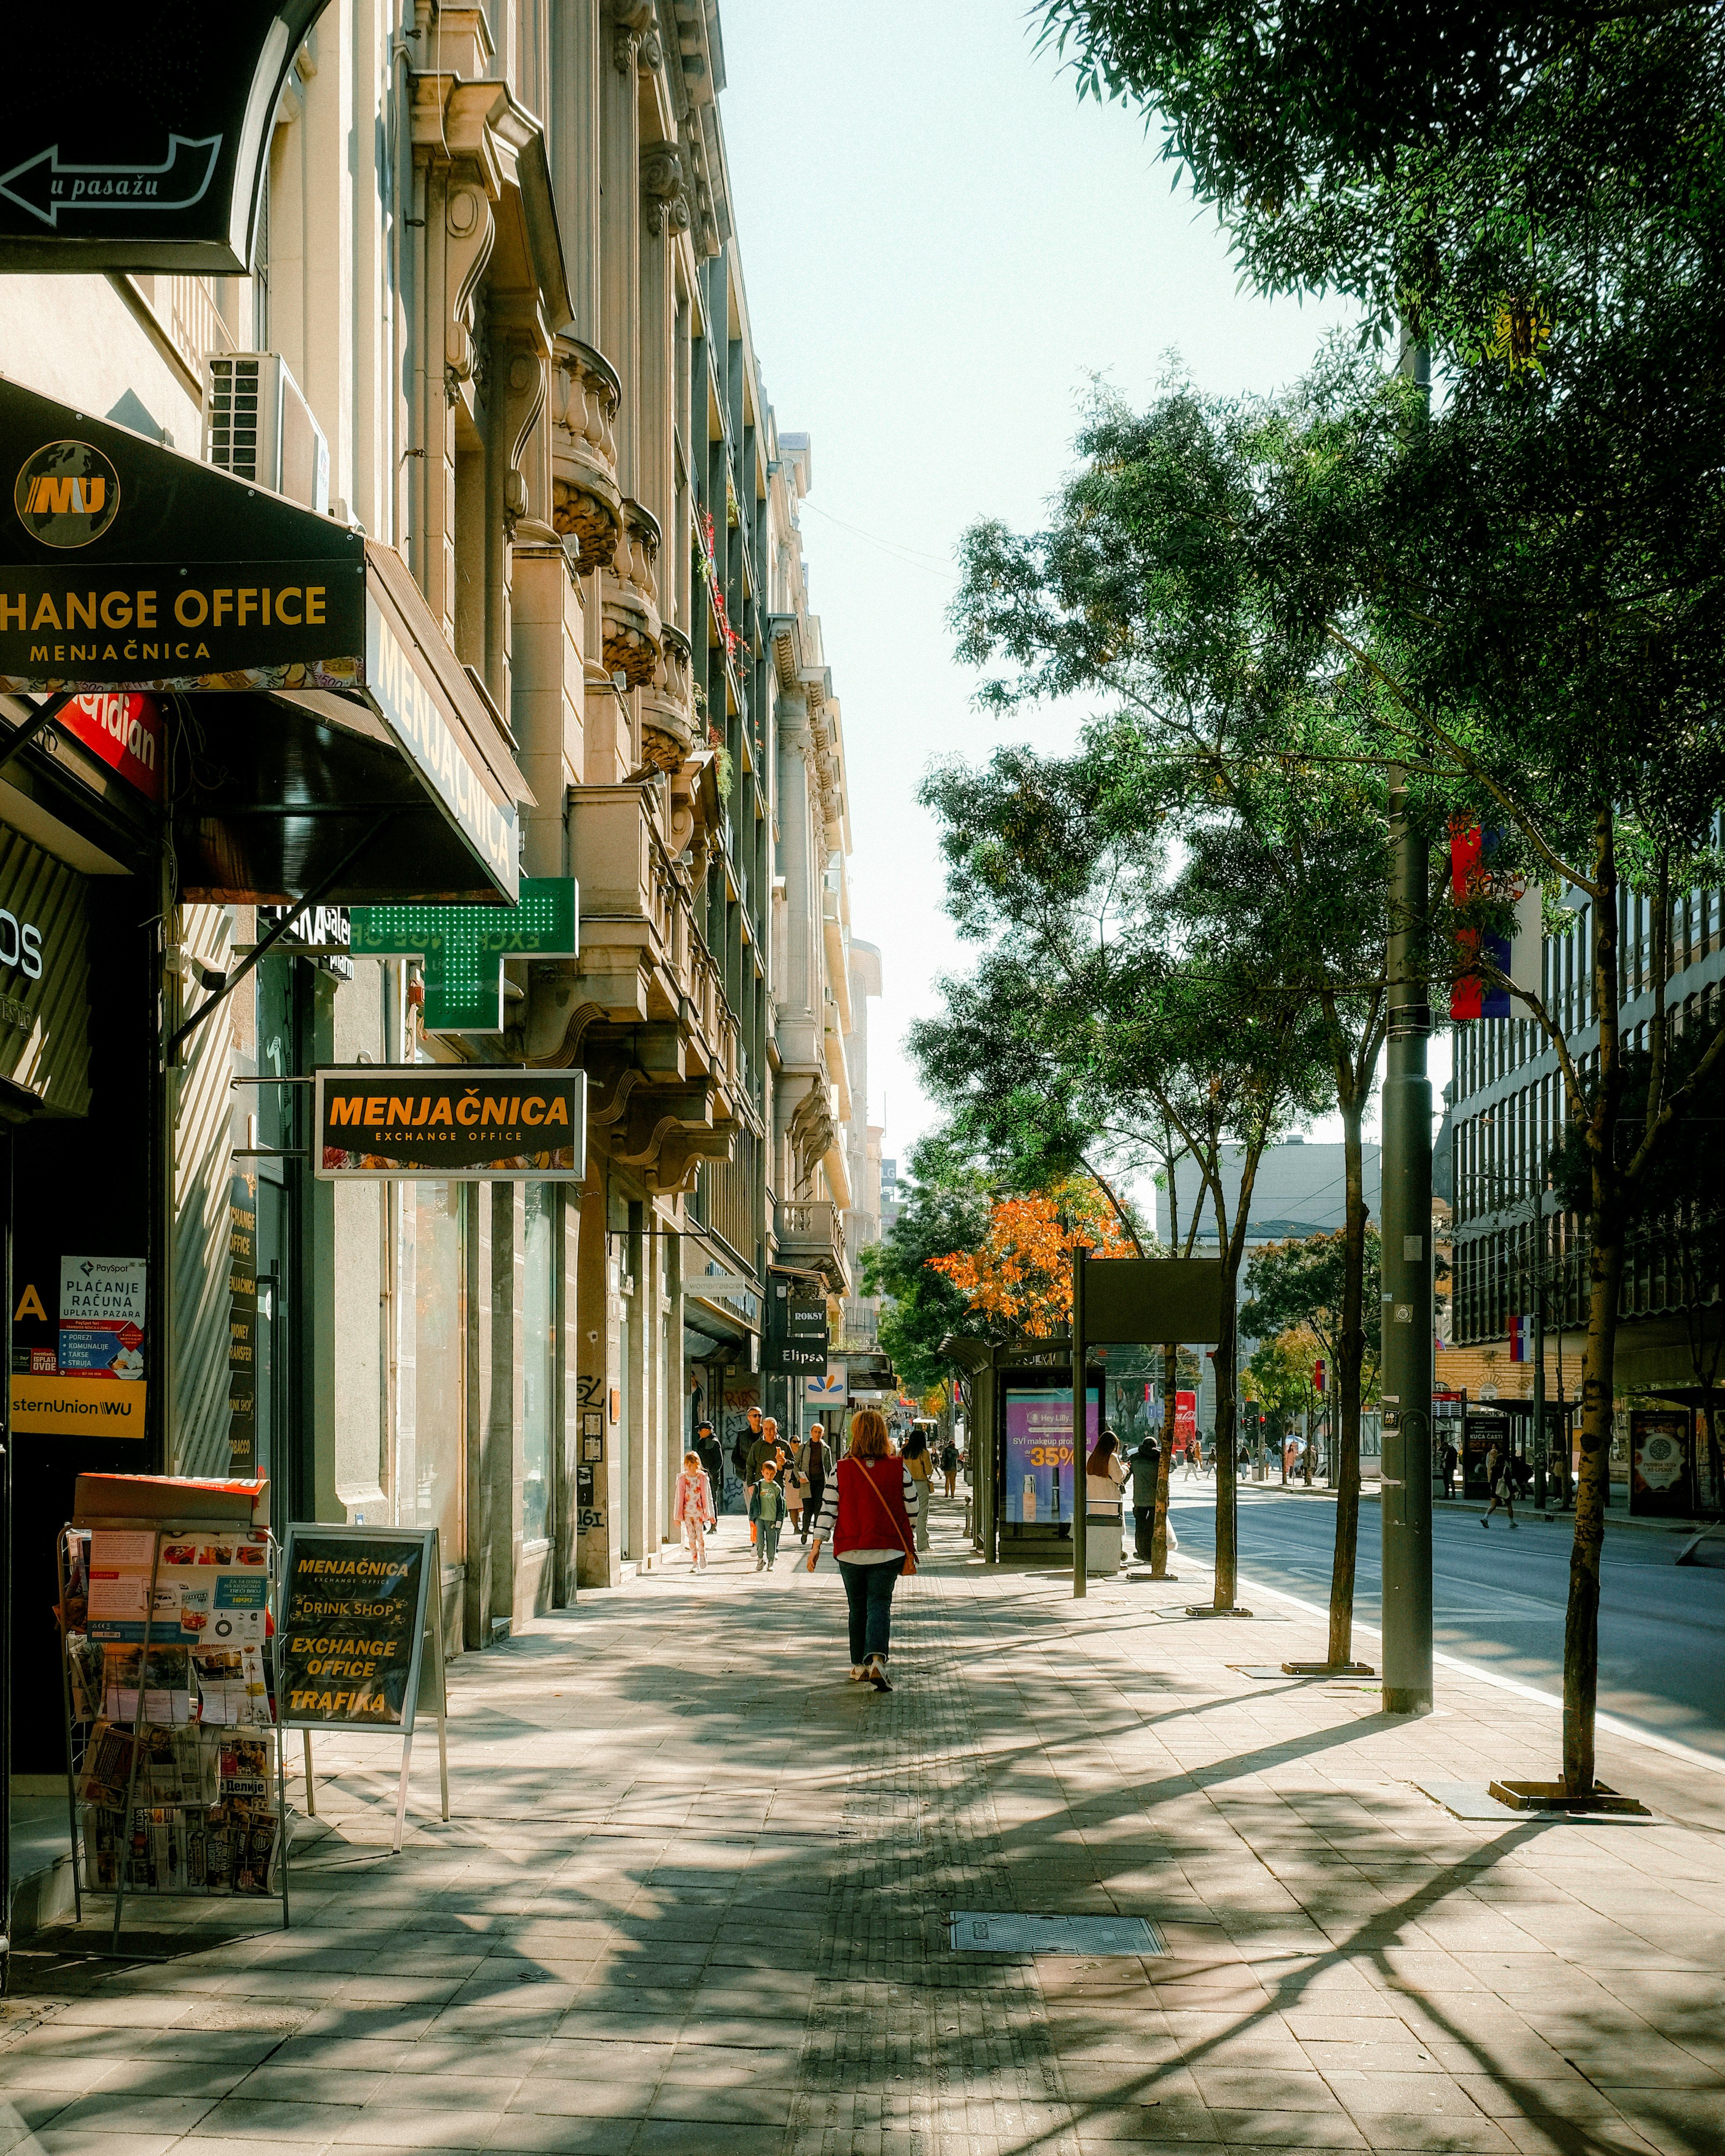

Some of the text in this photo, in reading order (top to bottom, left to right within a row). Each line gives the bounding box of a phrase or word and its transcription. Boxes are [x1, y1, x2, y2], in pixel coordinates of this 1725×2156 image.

[51, 174, 158, 200] u pasažu
[0, 586, 326, 631] HANGE OFFICE
[30, 639, 210, 662] MENJAČNICA
[329, 1088, 569, 1127] MENJAČNICA
[375, 1131, 522, 1141] EXCHANGE OFFICE
[96, 1264, 129, 1273] PaySpot
[66, 1280, 138, 1294] PLAĆANJE
[14, 1284, 48, 1321] A
[72, 1294, 132, 1308] RAČUNA
[103, 1310, 141, 1318] PAZARA
[794, 1311, 824, 1321] ROKSY
[782, 1350, 824, 1364] Elipsa
[33, 1362, 56, 1372] OVDE
[13, 1399, 98, 1415] sternUnion
[241, 1400, 251, 1412] SHOP
[1028, 1437, 1057, 1446] makeup
[298, 1557, 408, 1577] MENJAČNICA
[303, 1601, 394, 1616] DRINK SHOP
[291, 1637, 398, 1656] EXCHANGE
[307, 1660, 376, 1677] OFFICE
[290, 1690, 385, 1712] TRAFIKA
